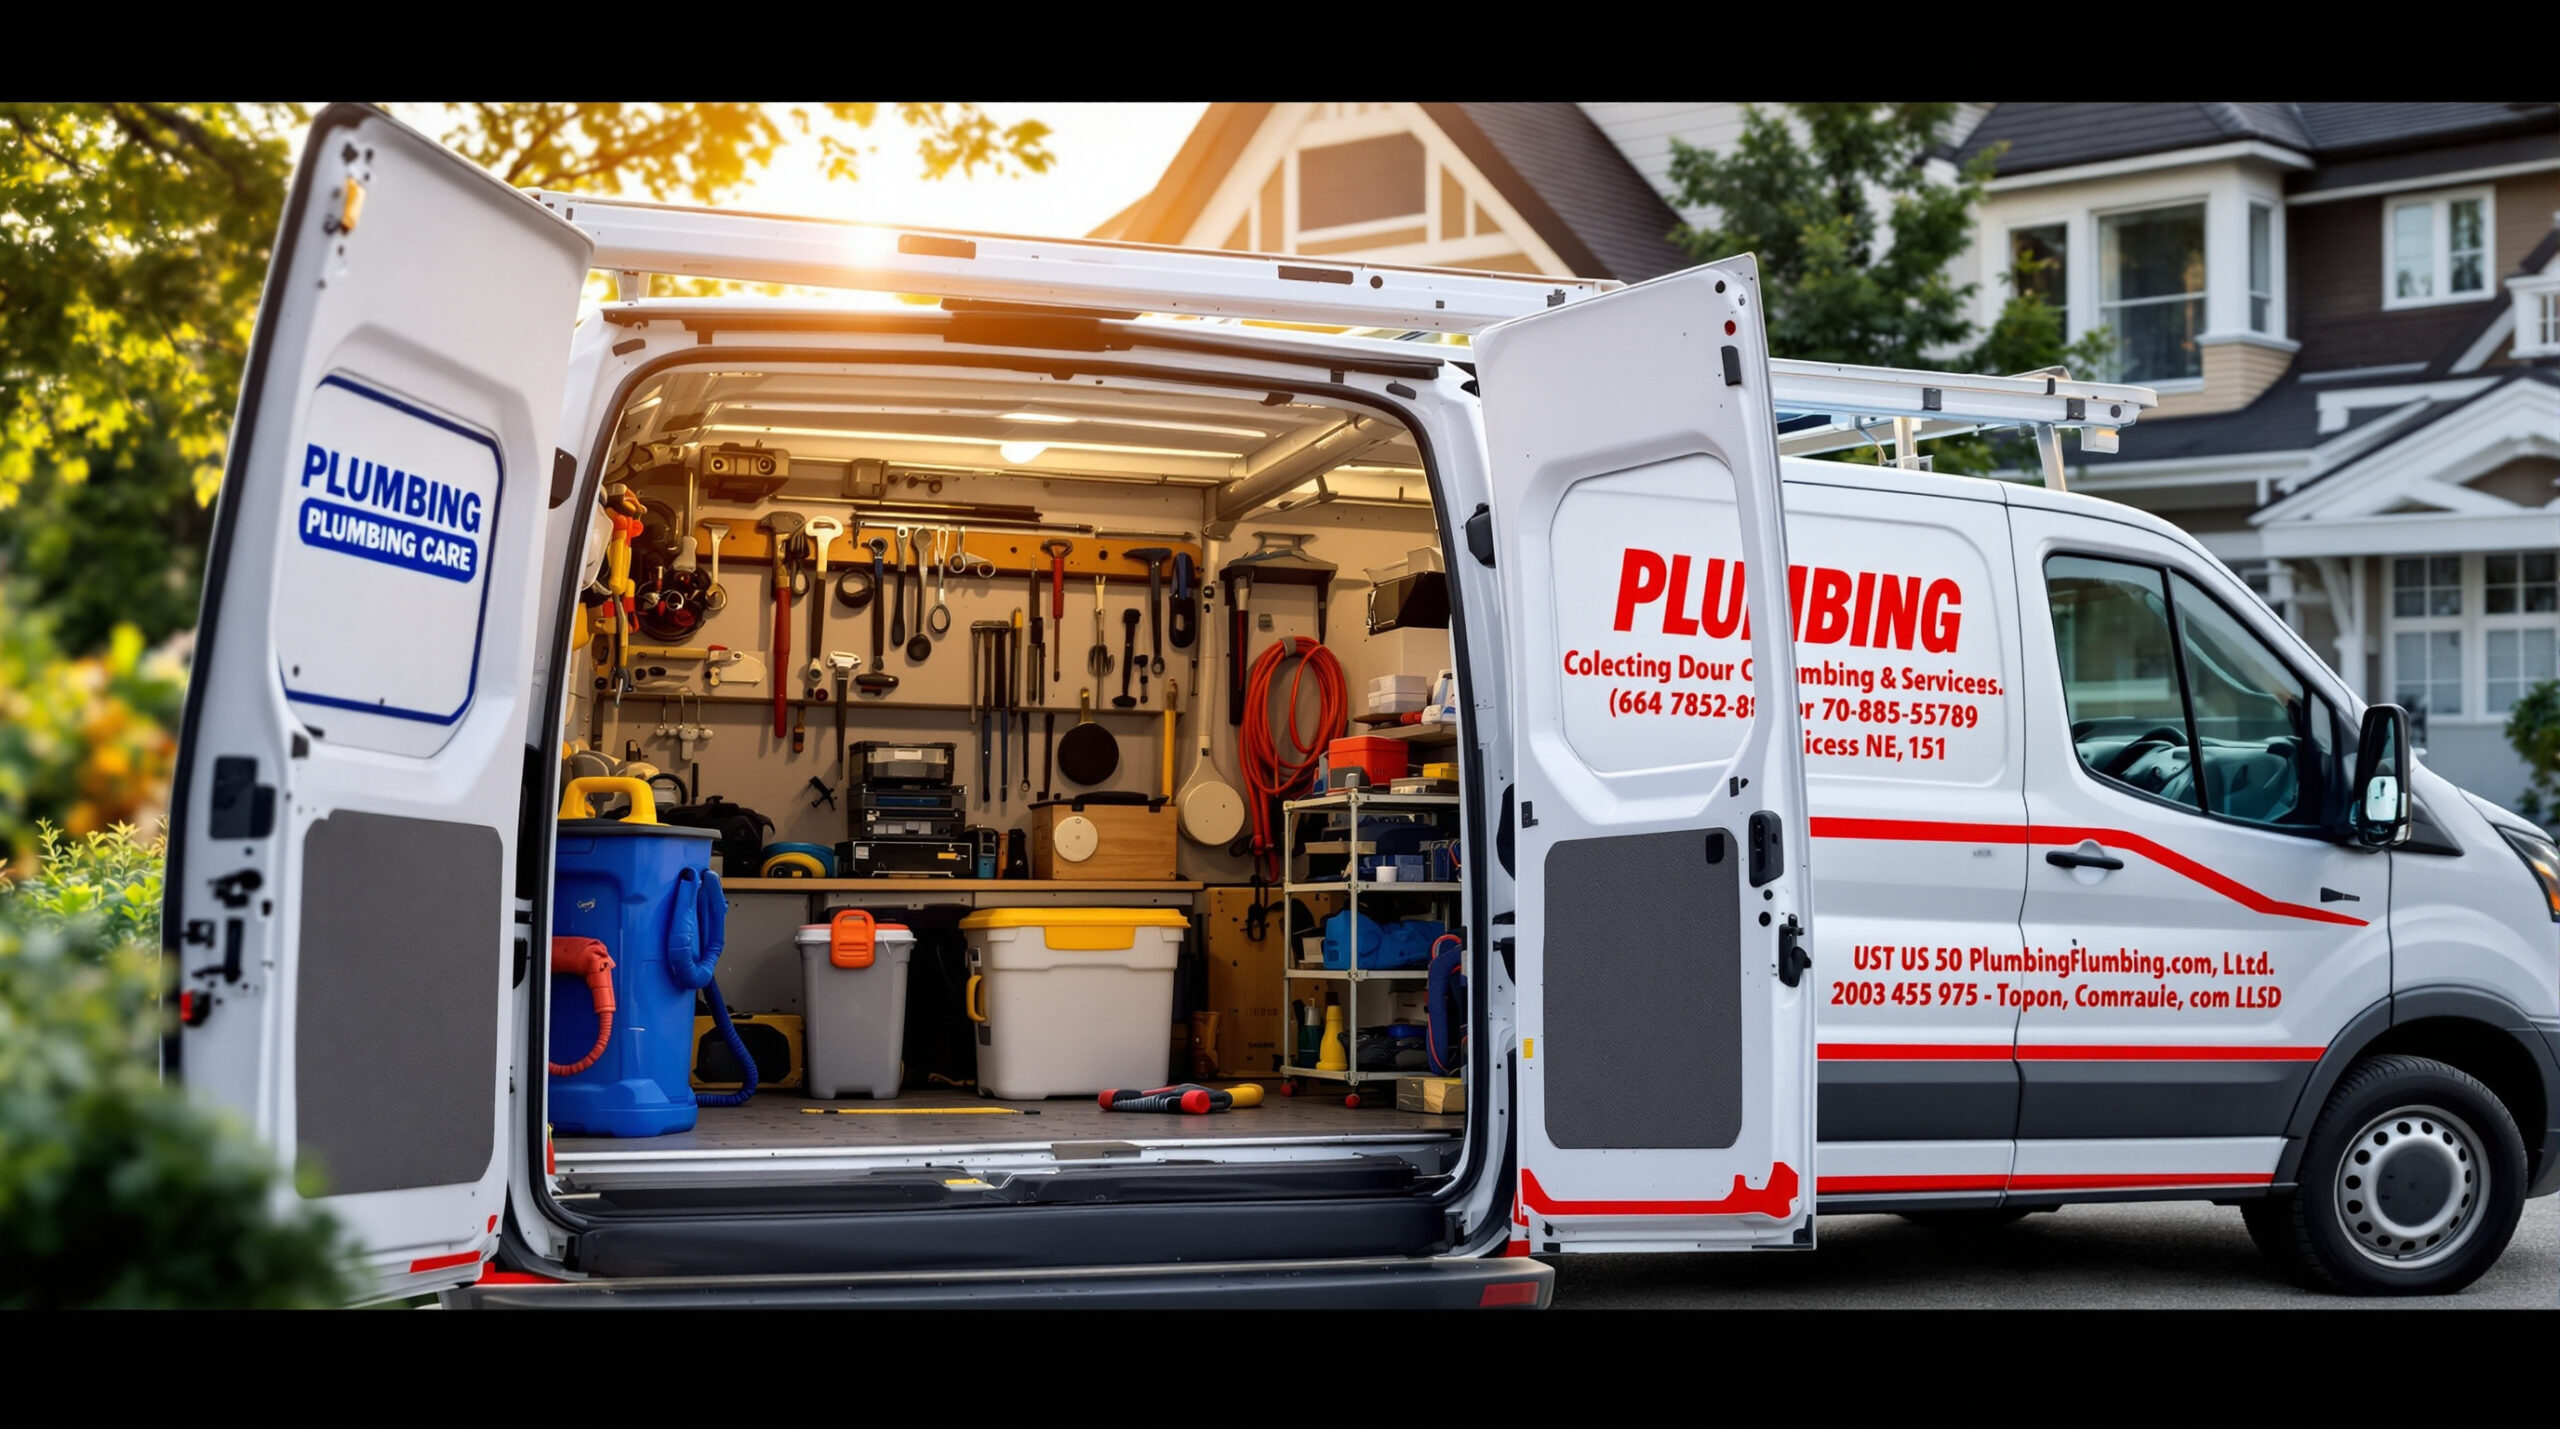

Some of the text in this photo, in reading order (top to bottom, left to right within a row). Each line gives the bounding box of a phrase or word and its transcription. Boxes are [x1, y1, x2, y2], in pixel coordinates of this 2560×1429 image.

[300, 443, 482, 534] PLUMBING
[306, 507, 473, 572] PLUMBING CARE
[1564, 650, 1673, 684] Colecting
[1678, 654, 1735, 681] Dour
[1880, 666, 1897, 689] &
[1609, 688, 1663, 718] (664
[1822, 698, 1979, 729] 70-885-55789
[1805, 730, 1946, 763] icess NE, 151
[1854, 946, 1896, 971] UST
[1901, 946, 1930, 971] US
[1935, 948, 1963, 972] 50
[1831, 981, 1886, 1006] 2003
[1891, 982, 1932, 1006] 455
[1938, 982, 1978, 1007] 975
[1997, 983, 2069, 1013] Topon,
[2190, 990, 2231, 1009] com
[2236, 986, 2282, 1009] LLSD
